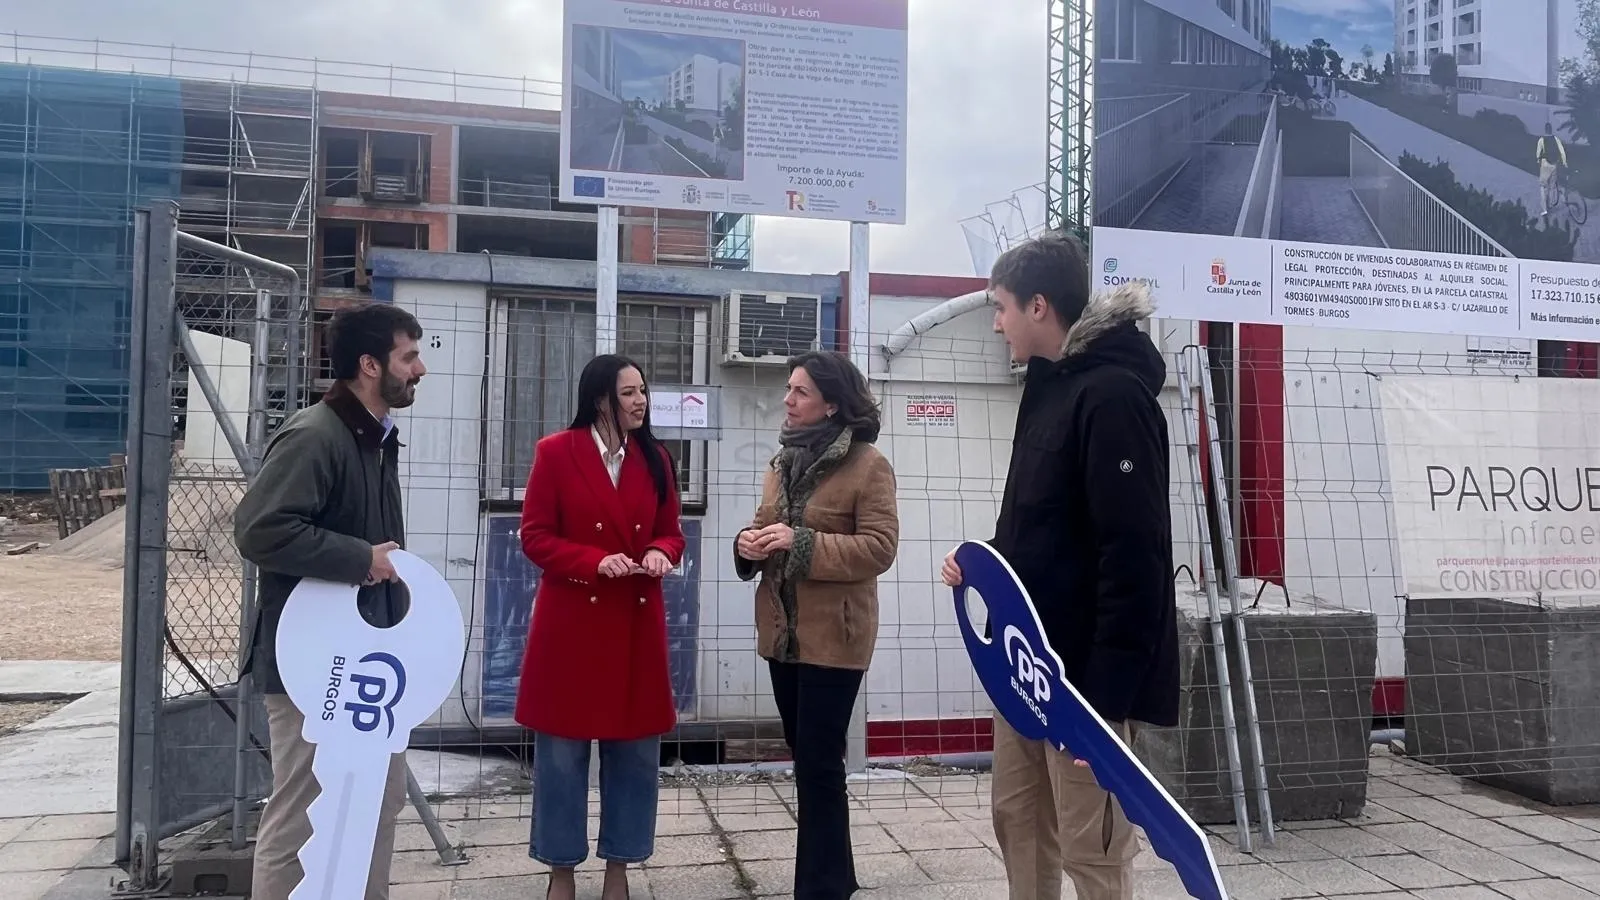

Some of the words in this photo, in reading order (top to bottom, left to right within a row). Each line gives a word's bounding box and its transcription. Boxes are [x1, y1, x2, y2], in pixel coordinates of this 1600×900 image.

[714, 0, 729, 9] de
[733, 0, 777, 14] Castilla
[781, 6, 788, 17] y
[791, 5, 820, 19] León
[777, 163, 811, 175] Importe
[813, 166, 825, 175] de
[827, 167, 834, 176] la
[836, 168, 865, 179] Ayuda:
[789, 176, 846, 189] 7.200.000,00
[848, 180, 854, 188] €
[1284, 248, 1342, 261] CONSTRUCCIÓN
[1344, 252, 1354, 261] DE
[1356, 254, 1393, 265] VIVIENDAS
[1395, 257, 1451, 269] COLABORATIVAS
[1454, 261, 1463, 269] EN
[1465, 261, 1496, 272] RÉGIMEN
[1499, 264, 1508, 273] DE
[1284, 263, 1308, 273] LEGAL
[1315, 264, 1365, 278] PROTECCIÓN,
[1372, 268, 1418, 280] DESTINADAS
[1424, 273, 1432, 281] AL
[1440, 274, 1474, 284] ALQUILER
[1530, 273, 1589, 287] Presupuesto
[1206, 285, 1234, 296] Castilla
[1235, 288, 1240, 297] y
[1242, 287, 1262, 296] León
[1228, 278, 1250, 287] Junta
[1252, 280, 1262, 288] de
[1284, 277, 1350, 290] PRINCIPALMENTE
[1352, 281, 1372, 291] PARA
[1374, 282, 1409, 295] JÓVENES,
[1411, 285, 1421, 294] EN
[1424, 287, 1433, 295] LA
[1435, 287, 1467, 297] PARCELA
[1469, 289, 1508, 301] CATASTRAL
[1531, 289, 1595, 304] 17.323.710.15
[1284, 306, 1315, 317] TORMES
[1318, 308, 1350, 319] BURGOS
[1384, 298, 1400, 308] SITO
[1402, 300, 1411, 308] EN
[1413, 300, 1420, 309] EL
[1422, 301, 1432, 309] AR
[1433, 302, 1446, 310] S-3
[1451, 303, 1461, 312] C/
[1462, 303, 1498, 314] LAZARILLO
[1499, 305, 1509, 314] DE
[1530, 312, 1547, 322] Más
[430, 335, 441, 349] 5
[1426, 465, 1600, 512] PARQUE
[1439, 568, 1600, 592] CONSTRUCCIO
[321, 655, 346, 721] BURGOS
[1010, 676, 1048, 726] BURGOS
